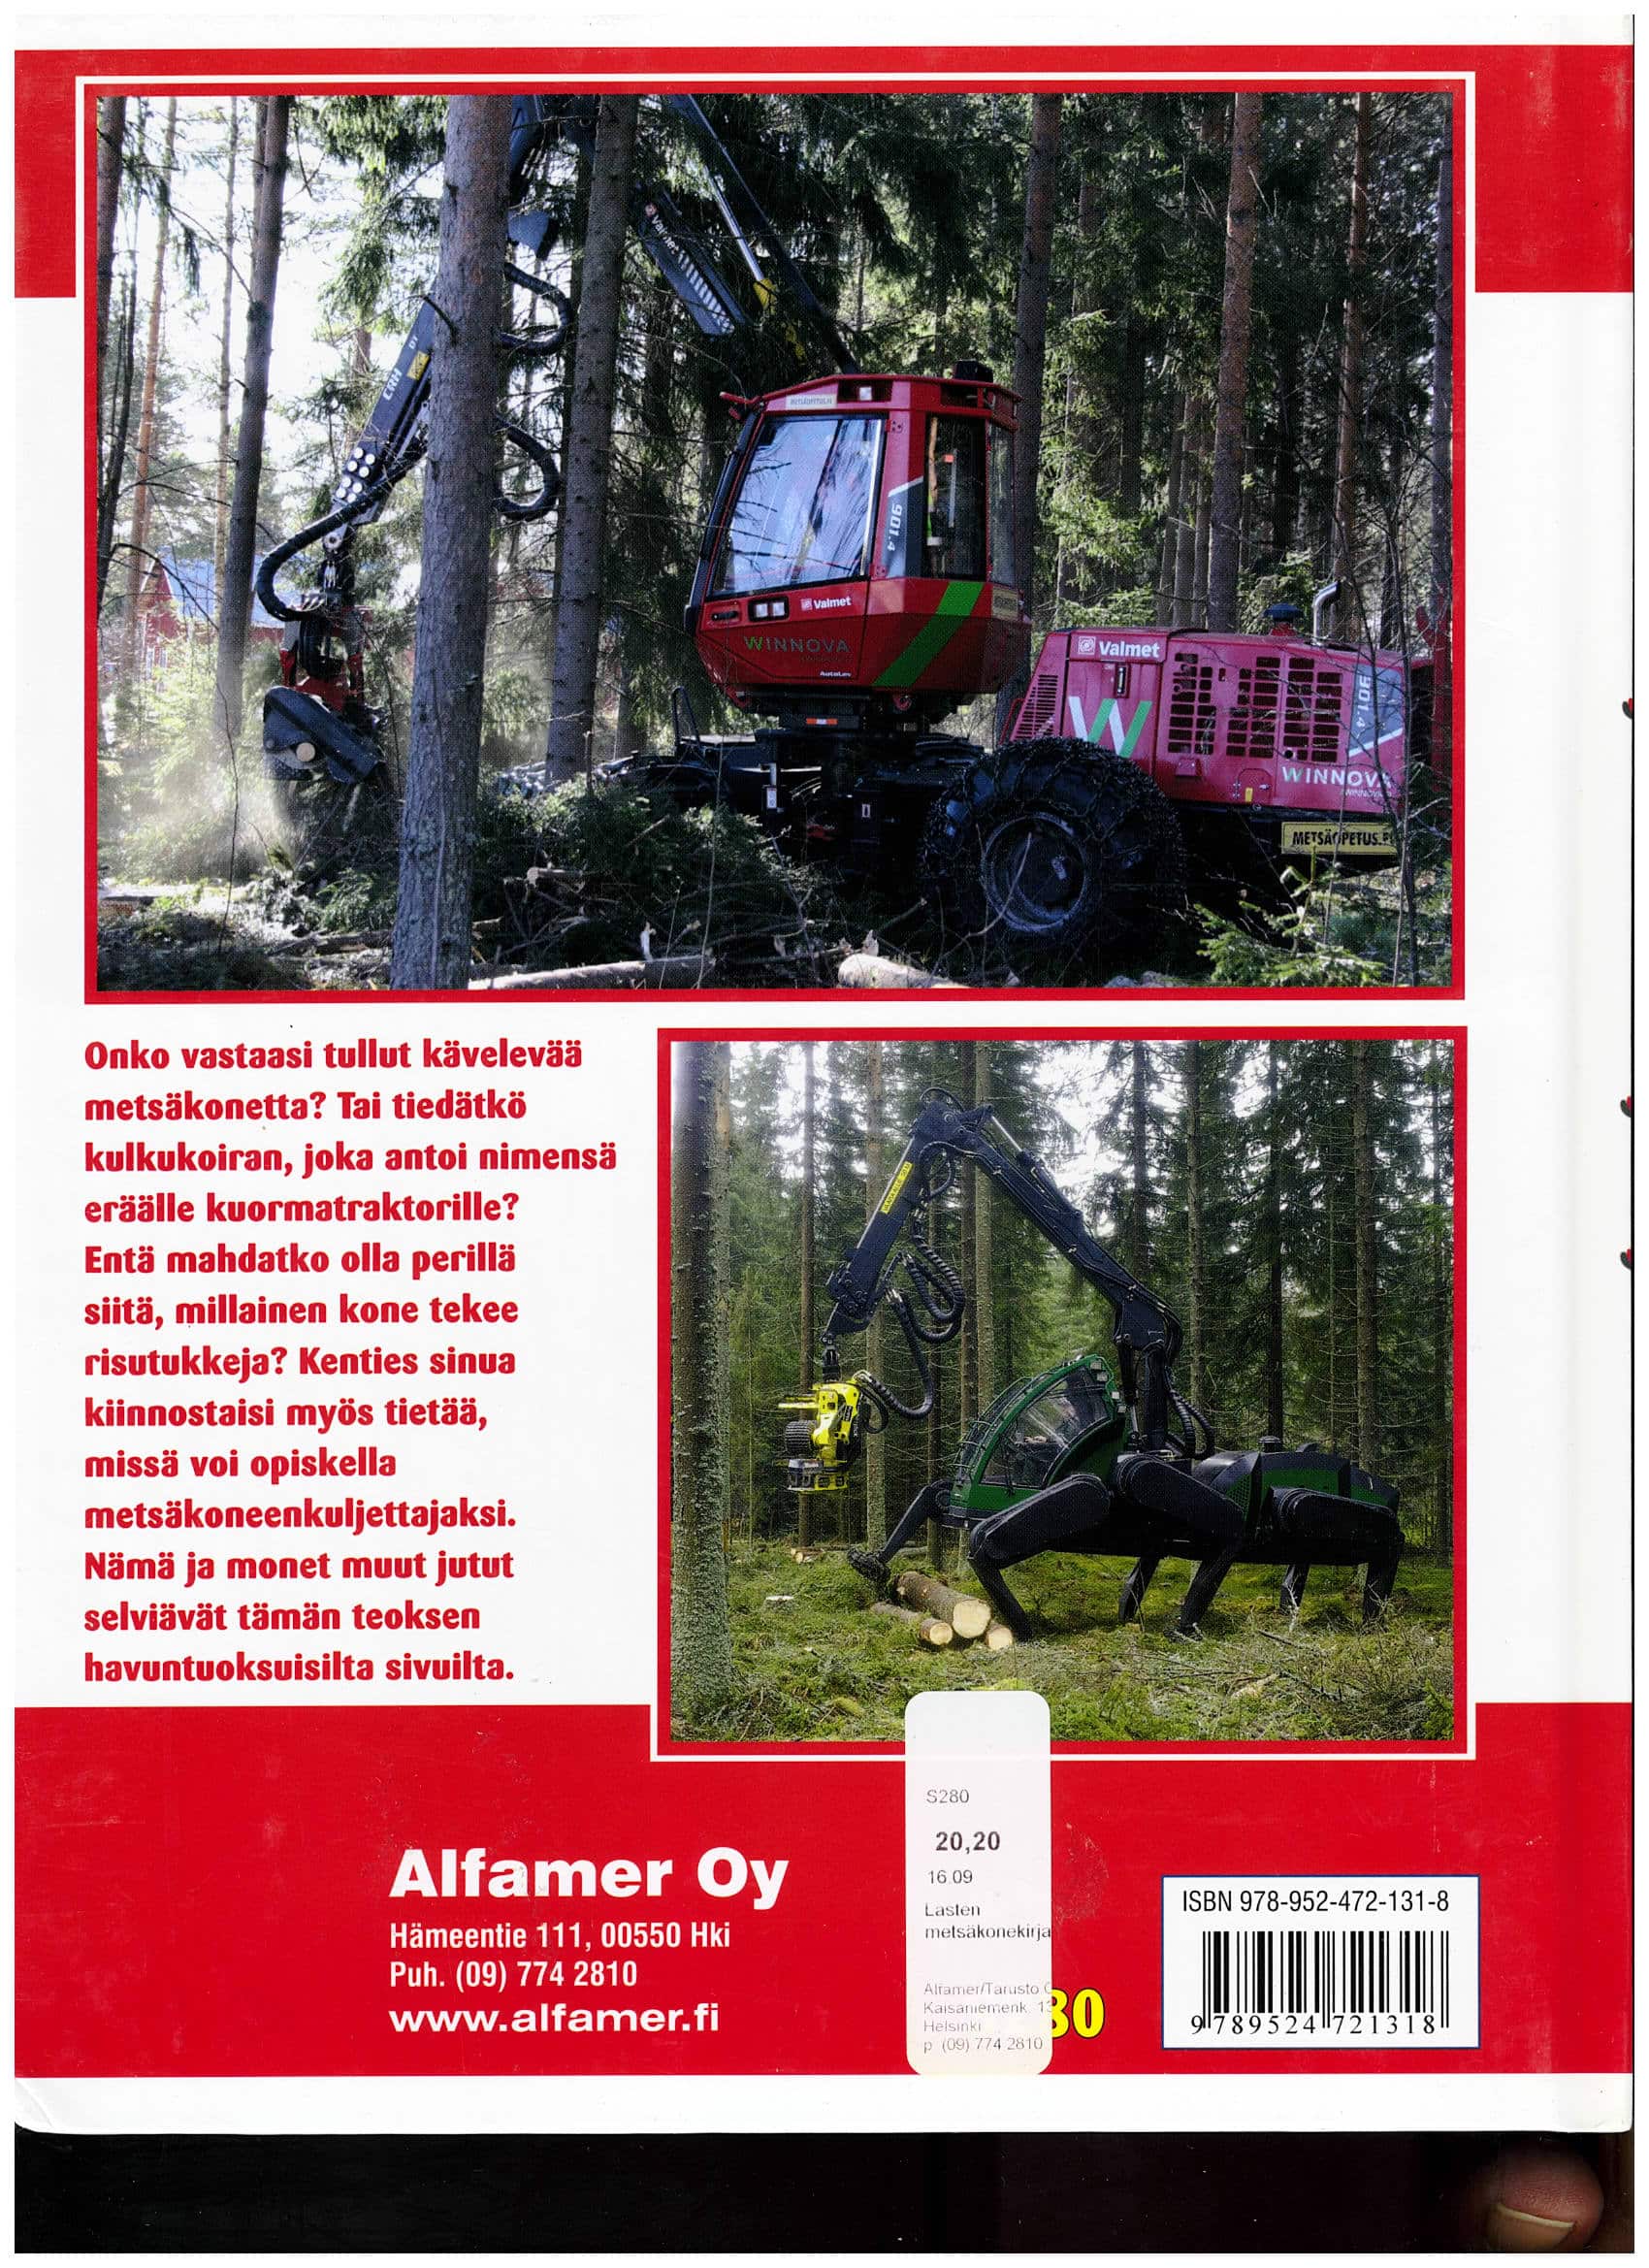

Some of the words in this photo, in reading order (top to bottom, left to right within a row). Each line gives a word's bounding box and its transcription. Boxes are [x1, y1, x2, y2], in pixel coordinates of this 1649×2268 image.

[887, 503, 903, 552] 901.4
[814, 596, 852, 609] Valmet
[744, 635, 850, 653] WINNOVA
[1099, 640, 1160, 658] Valmet
[84, 1039, 170, 1070] Onko
[180, 1040, 312, 1070] vastaasi
[322, 1038, 412, 1069] tullut
[423, 1037, 582, 1069] kävelevää
[84, 1089, 327, 1121] metsäkonetta?
[337, 1091, 381, 1120] Tai
[391, 1088, 527, 1119] tiedätkö
[84, 1141, 293, 1178] kulkukoiran,
[301, 1140, 373, 1180] joka
[384, 1142, 468, 1171] antoi
[479, 1142, 617, 1171] nimensä
[84, 1192, 195, 1223] eräälle
[207, 1190, 520, 1222] kuormatraktorille?
[84, 1245, 155, 1274] Entä
[167, 1242, 330, 1274] mahdatko
[340, 1242, 401, 1273] olla
[411, 1241, 516, 1280] perillä
[84, 1296, 164, 1331] siitä,
[176, 1293, 327, 1324] millainen
[340, 1293, 419, 1324] kone
[429, 1292, 519, 1324] tekee
[84, 1345, 288, 1384] risutukkeja?
[299, 1345, 419, 1376] Kenties
[429, 1345, 516, 1375] sinua
[84, 1396, 275, 1427] kiinnostaisi
[286, 1397, 374, 1435] myös
[384, 1397, 488, 1432] tietää,
[84, 1449, 178, 1478] missä
[189, 1448, 239, 1477] voi
[250, 1445, 397, 1485] opiskella
[84, 1497, 516, 1537] metsäkoneenkuljettajaksi.
[84, 1551, 176, 1580] Nämä
[183, 1551, 214, 1588] ja
[227, 1552, 332, 1579] monet
[341, 1552, 428, 1579] muut
[435, 1549, 515, 1587] jutut
[83, 1601, 228, 1632] selviävät
[237, 1602, 340, 1631] tämän
[351, 1599, 480, 1631] teoksen
[84, 1650, 374, 1682] havuntuoksuisilta
[385, 1650, 514, 1681] sivuilta.
[926, 1789, 970, 1804] S280
[935, 1831, 1001, 1855] 20,20
[388, 1847, 673, 1898] Alfamer
[696, 1846, 790, 1910] Oy
[924, 1902, 981, 1917] Lasten
[1183, 1890, 1232, 1912] ISBN
[1240, 1890, 1449, 1912] 978-952-472-131-8
[390, 1922, 527, 1949] Hämeentie
[536, 1922, 591, 1952] 111,
[600, 1922, 681, 1948] 00550
[691, 1921, 730, 1948] Hki
[924, 1924, 1052, 1942] metsäkonekirja
[390, 1960, 445, 1988] Puh.
[456, 1960, 507, 1993] (09)
[516, 1960, 565, 1987] 774
[573, 1960, 637, 1987] 2810
[388, 2002, 719, 2033] www.alfamer.fi
[923, 2020, 983, 2032] Helsinki
[942, 2039, 970, 2054] (09)
[975, 2037, 1002, 2051] 774
[1007, 2037, 1044, 2051] 2810
